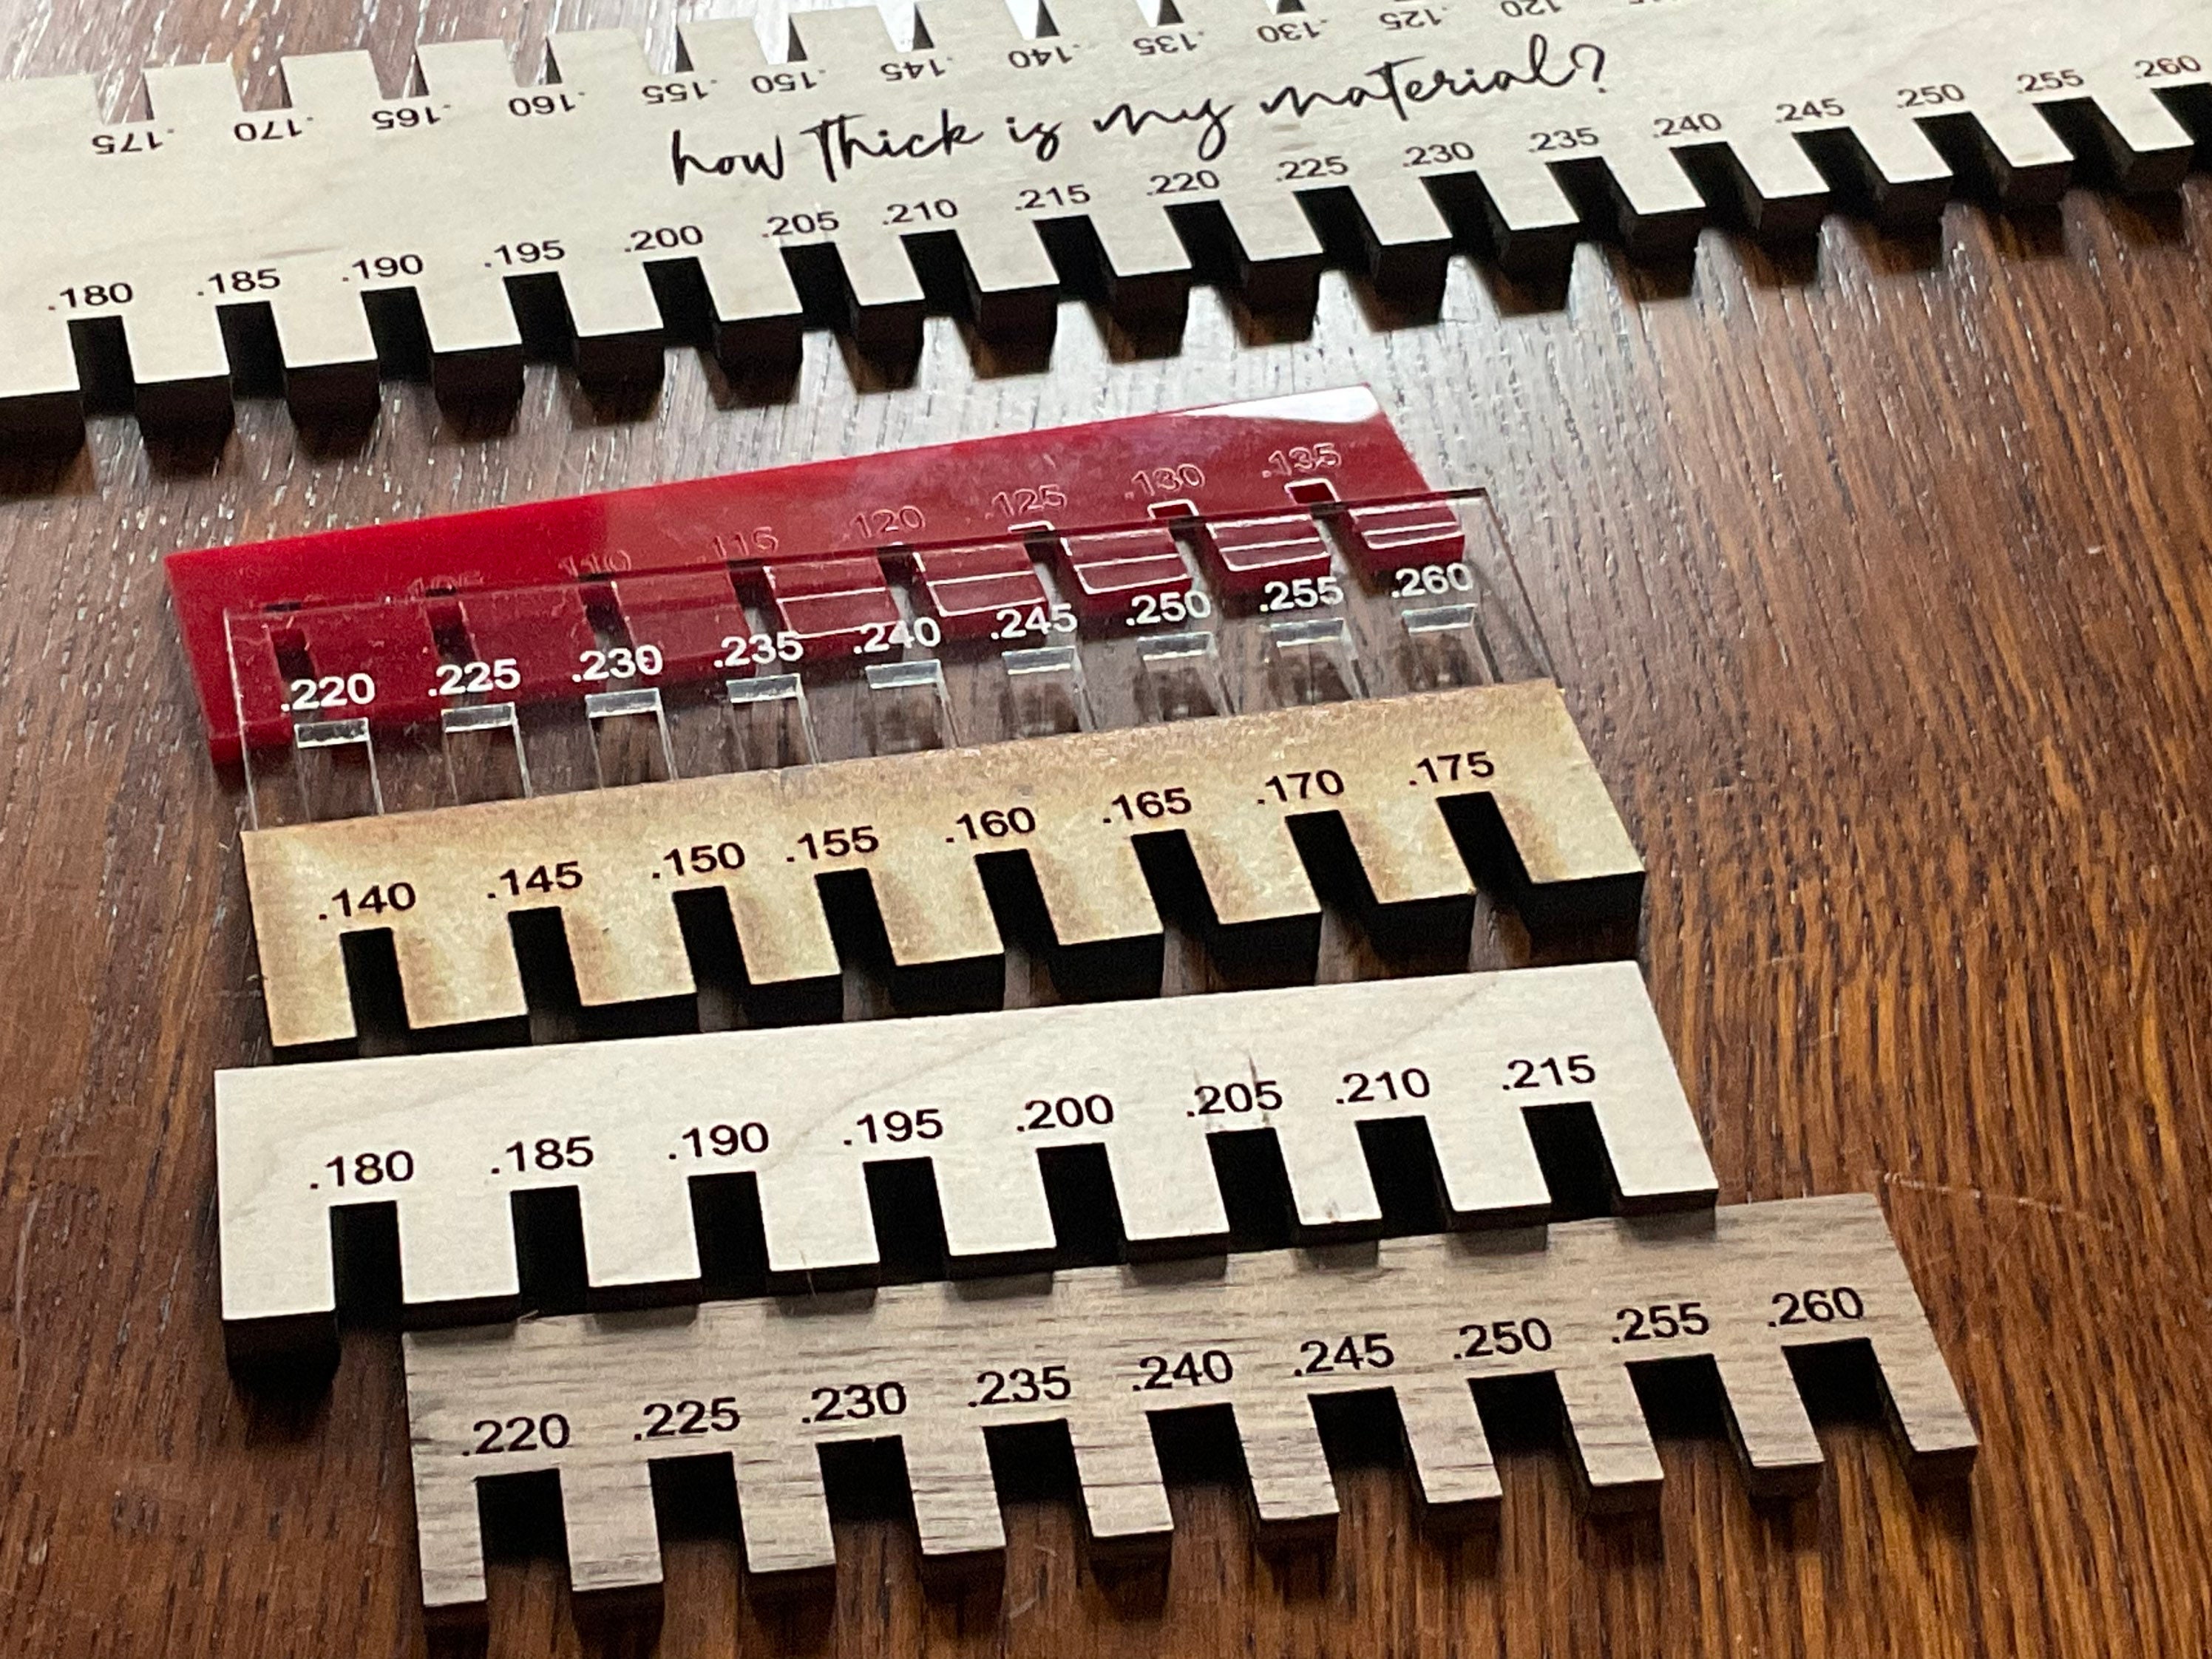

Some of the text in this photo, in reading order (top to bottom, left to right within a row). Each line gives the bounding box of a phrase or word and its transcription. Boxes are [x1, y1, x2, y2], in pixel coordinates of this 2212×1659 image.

[1380, 7, 1448, 30] .125
[1258, 20, 1326, 42] .130
[1133, 32, 1204, 55] .135
[1008, 45, 1079, 68] .140
[751, 70, 824, 93] .150
[881, 58, 951, 81] .145
[509, 92, 584, 116] .160
[642, 80, 716, 104] .155
[372, 105, 450, 129] .165
[672, 33, 1606, 185] how thick is my material?
[234, 117, 313, 142] .170
[92, 129, 173, 155] .175
[49, 55, 2201, 310] .180 .185 .190 .195 .200 .205 .210 .215 .220 .225 .230 .235 .240 .245 .250 .255 .260
[844, 505, 926, 541] .120
[985, 484, 1068, 520] .125
[1125, 464, 1205, 501] .130
[1263, 442, 1343, 478] .135
[280, 563, 1473, 712] .220 .225 .230 .235 .240 .245 .250 .255 .260
[319, 751, 1494, 920] .140 .145 .150 .155 .160 .165 .170 .175
[311, 1055, 1595, 1189] .180 .185 .190 .195 .200 .205 .210 .215
[461, 1287, 1867, 1456] .220 .225 .230 .235 .240 .245 .250 .255 .260
